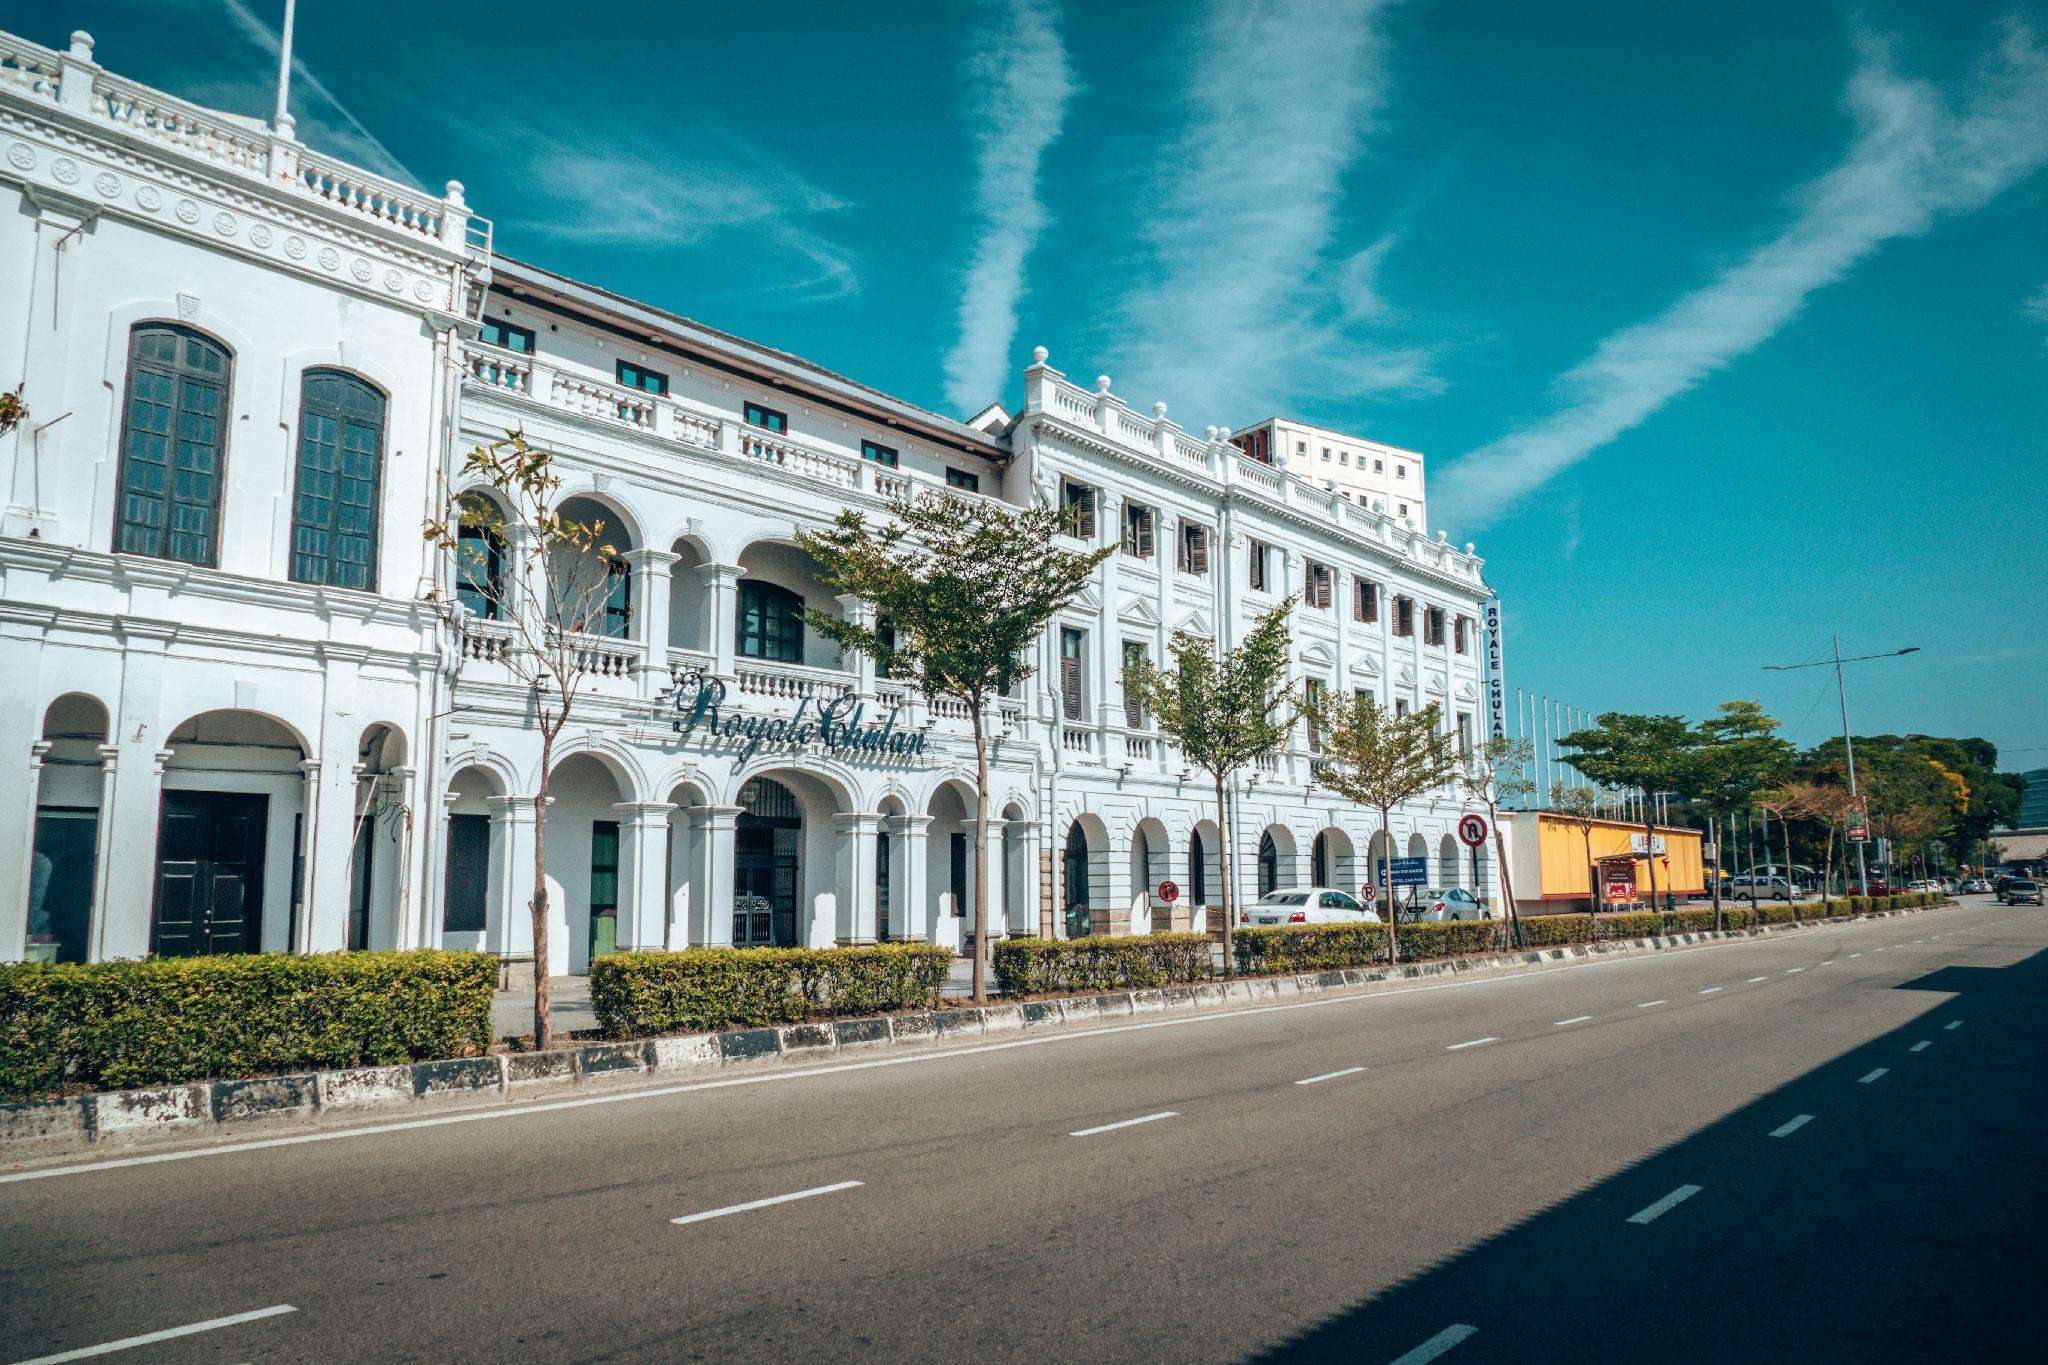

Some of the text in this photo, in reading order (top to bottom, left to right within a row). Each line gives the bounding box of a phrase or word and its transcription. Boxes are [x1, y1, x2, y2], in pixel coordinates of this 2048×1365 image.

[1488, 608, 1499, 670] ROYALE
[673, 672, 928, 763] Royale Chulan
